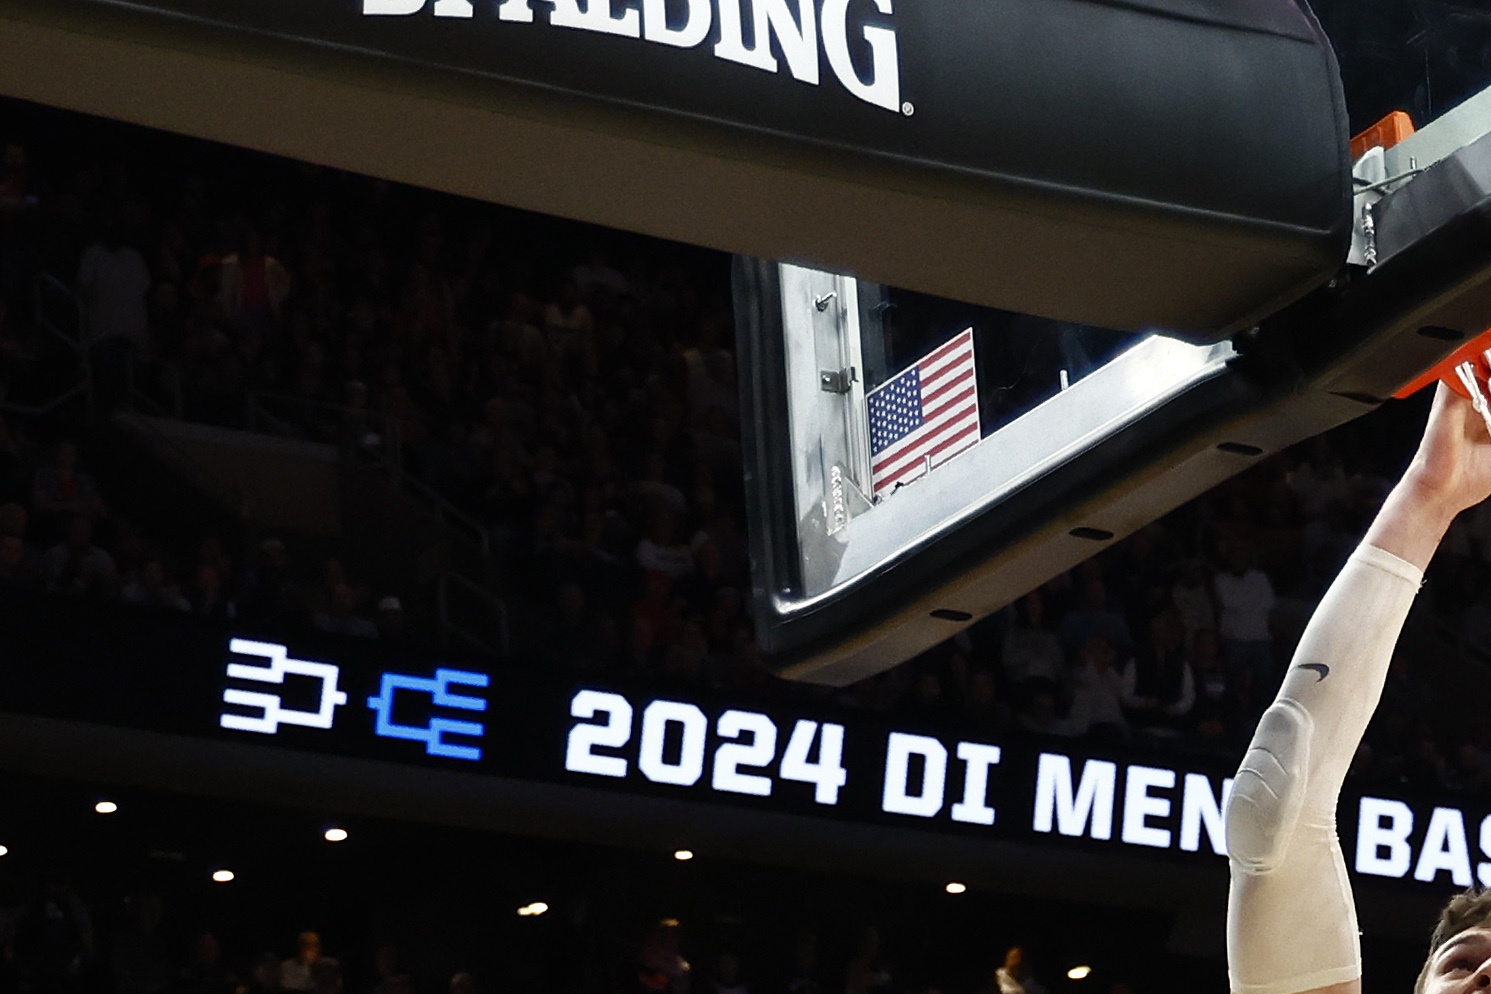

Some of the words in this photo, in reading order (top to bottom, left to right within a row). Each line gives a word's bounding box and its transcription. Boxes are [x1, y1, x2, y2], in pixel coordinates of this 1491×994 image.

[565, 689, 847, 805] 2024
[881, 731, 1001, 826] DI
[1033, 752, 1233, 856] MEN
